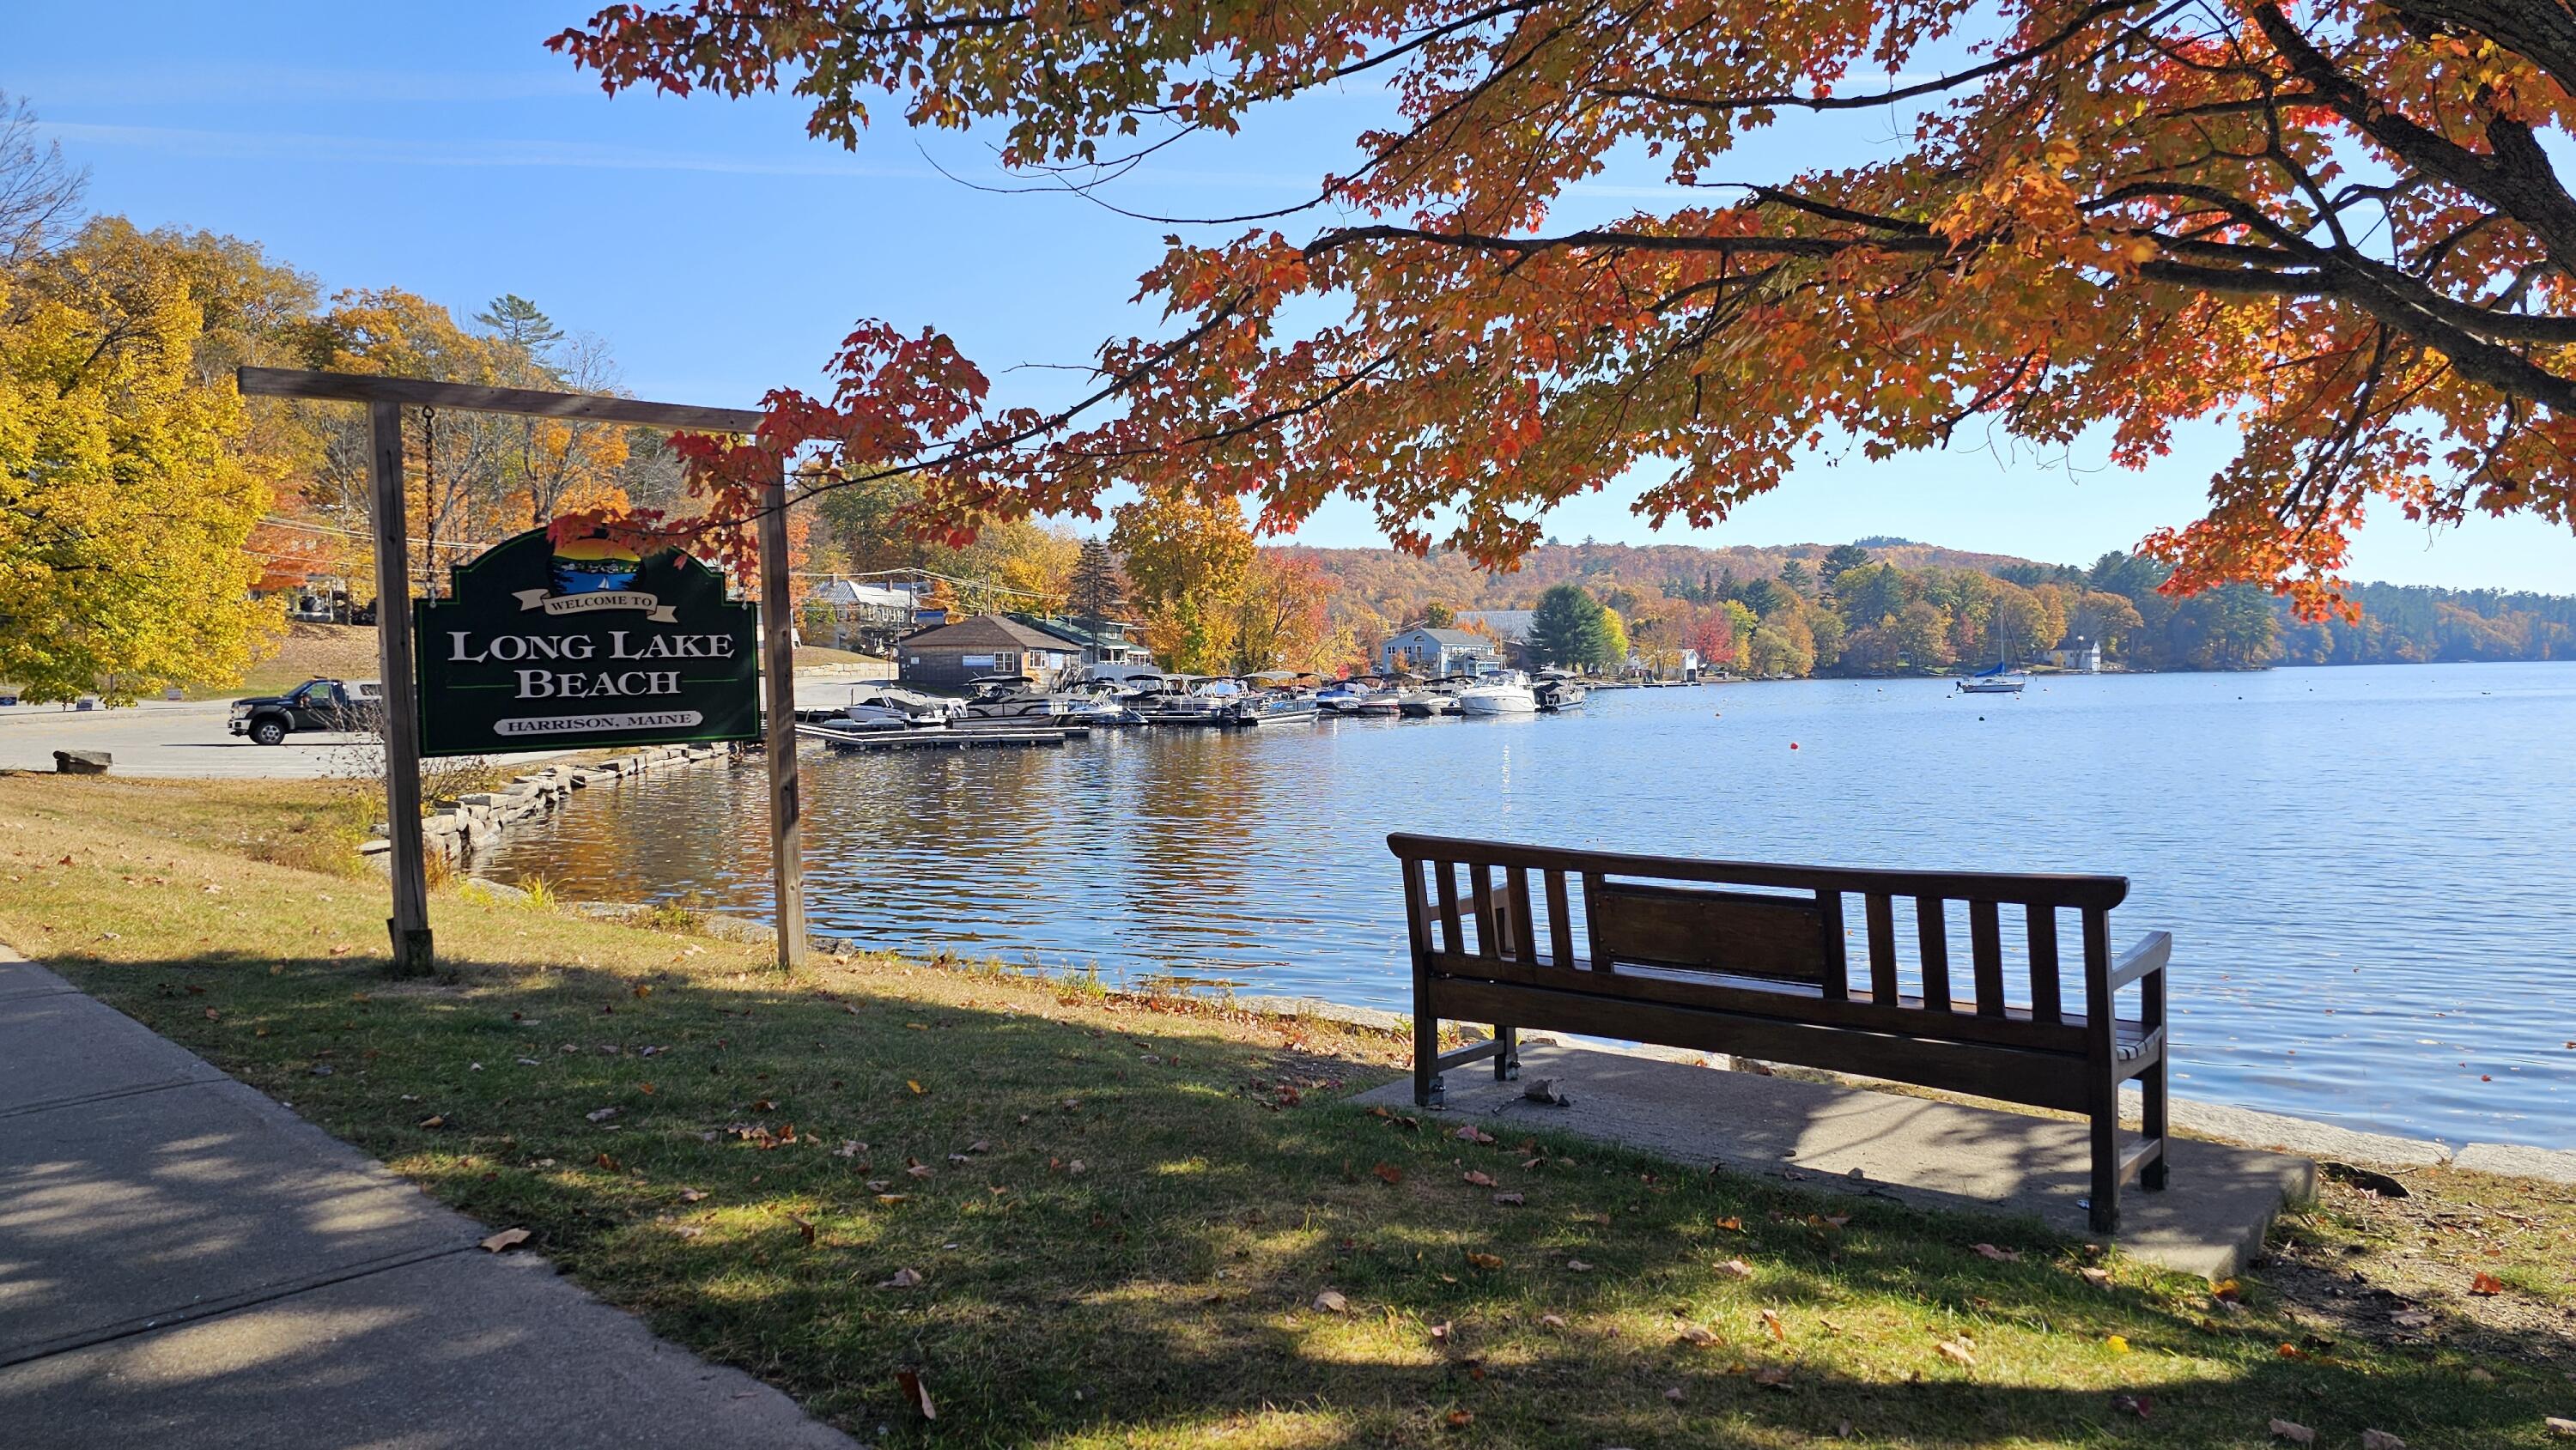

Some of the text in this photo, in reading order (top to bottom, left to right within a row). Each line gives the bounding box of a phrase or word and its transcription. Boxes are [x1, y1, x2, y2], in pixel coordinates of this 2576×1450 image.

[550, 596, 652, 610] WELCOME TO
[447, 631, 735, 663] LONG LAKE
[513, 670, 681, 698] BEACH
[507, 714, 691, 731] HARRISON, MAINE
